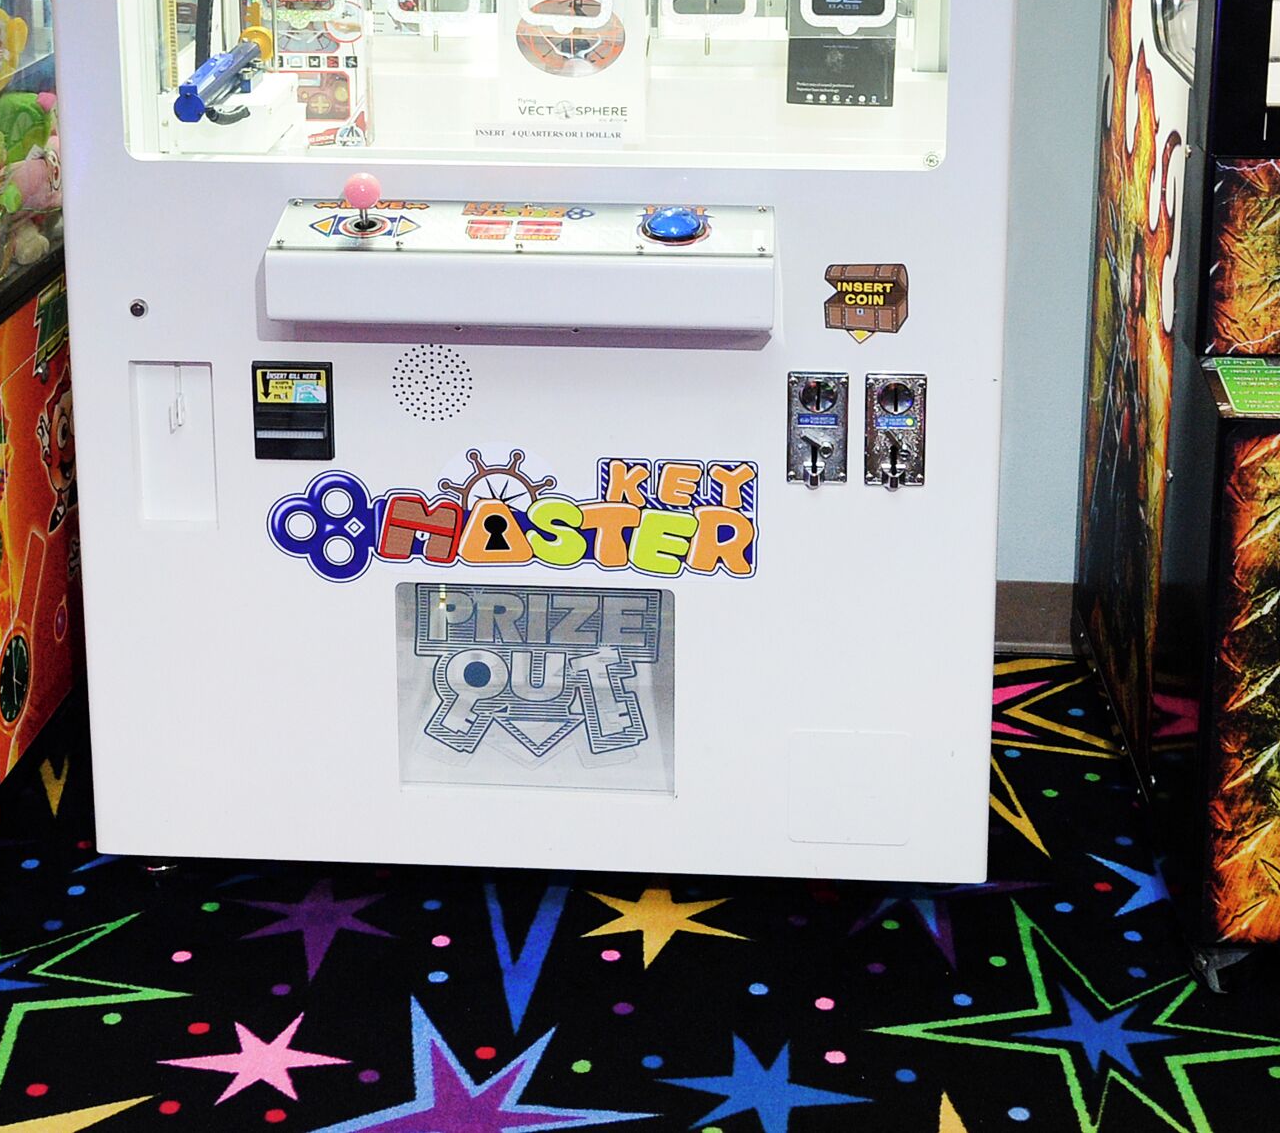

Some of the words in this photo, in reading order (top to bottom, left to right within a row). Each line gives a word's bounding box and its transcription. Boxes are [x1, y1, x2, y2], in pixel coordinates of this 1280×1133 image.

[340, 200, 405, 209] MVE
[837, 281, 894, 293] INSERT
[844, 293, 885, 305] COIN
[266, 371, 287, 379] INSERT
[607, 459, 754, 506] KEY
[377, 495, 754, 575] MASTER
[427, 591, 650, 646] PRIZE
[441, 646, 628, 737] OUT
